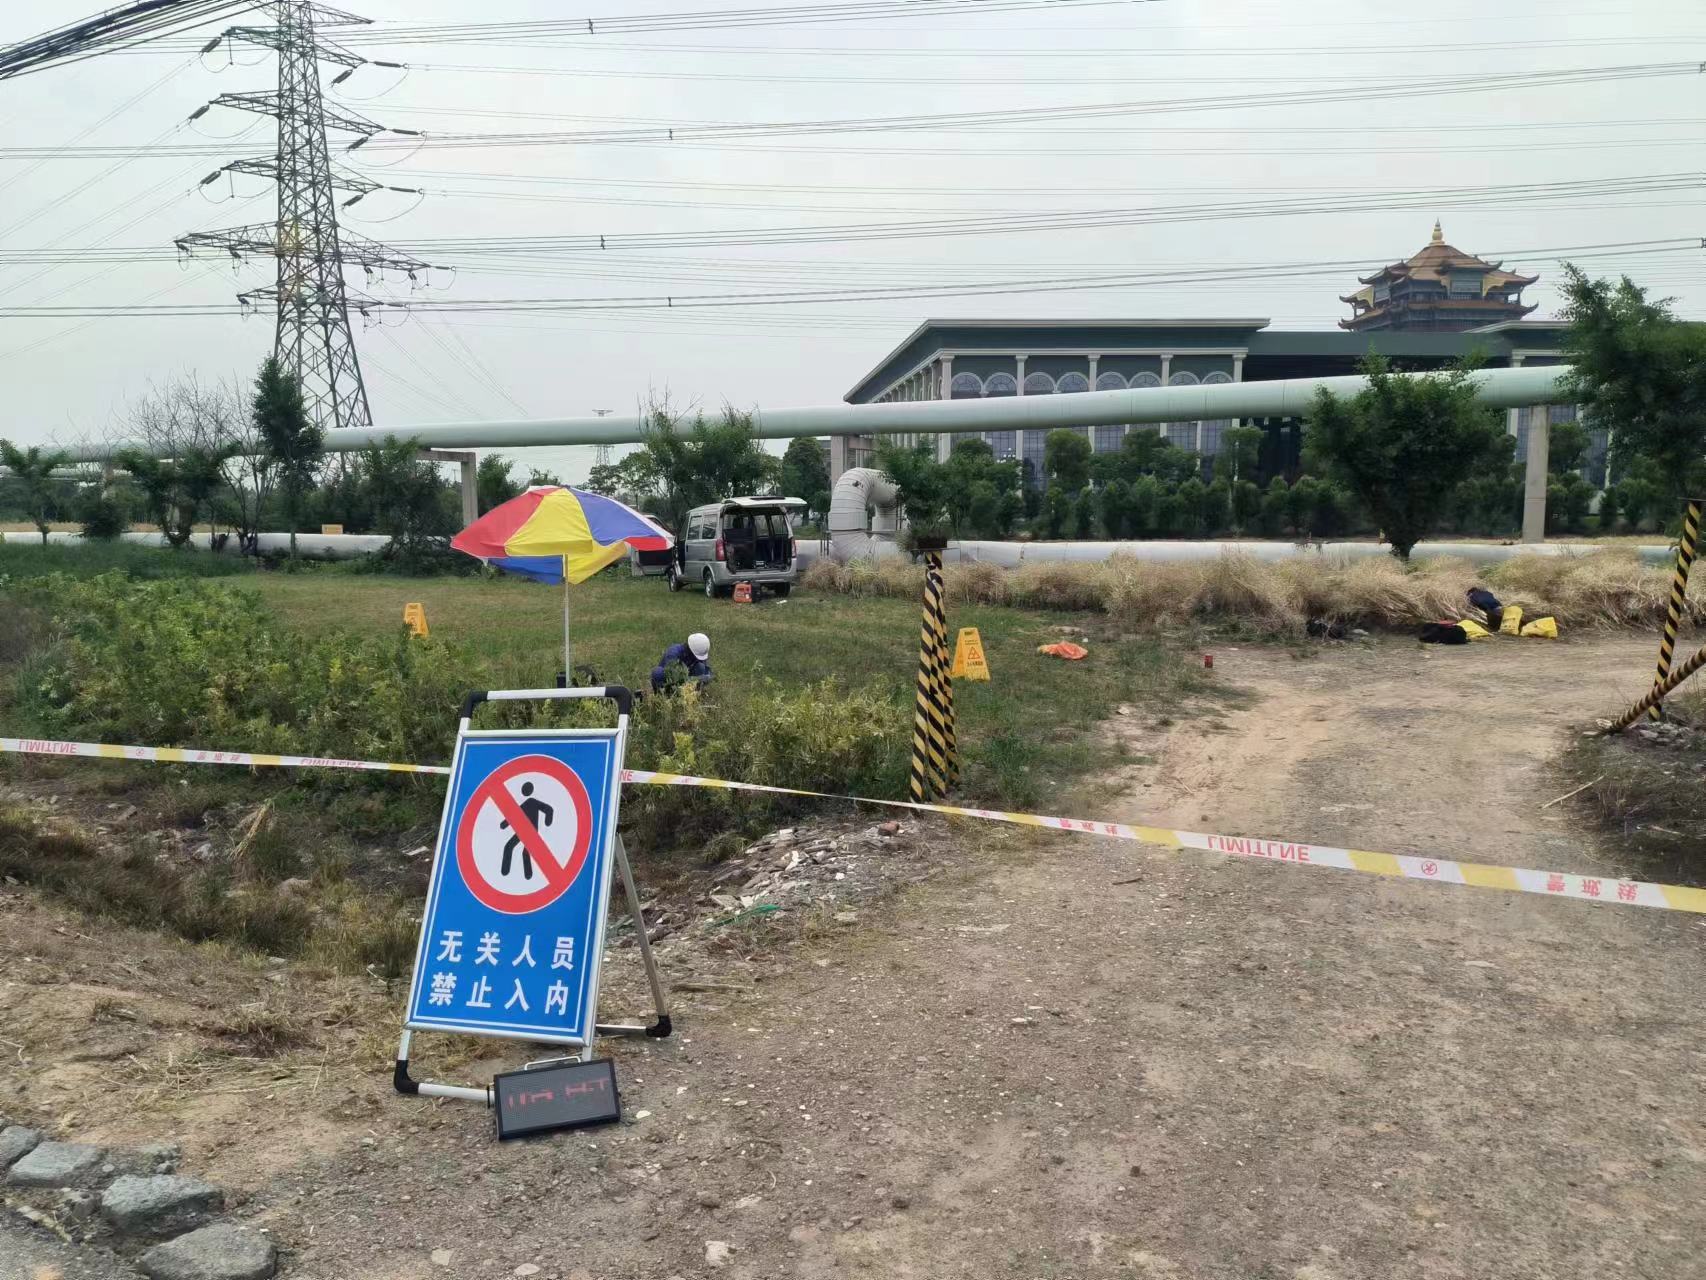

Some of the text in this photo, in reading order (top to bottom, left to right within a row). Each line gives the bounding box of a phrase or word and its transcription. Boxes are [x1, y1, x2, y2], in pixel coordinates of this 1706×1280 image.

[436, 930, 574, 970] 无关人员
[429, 972, 569, 1016] 禁止入内
